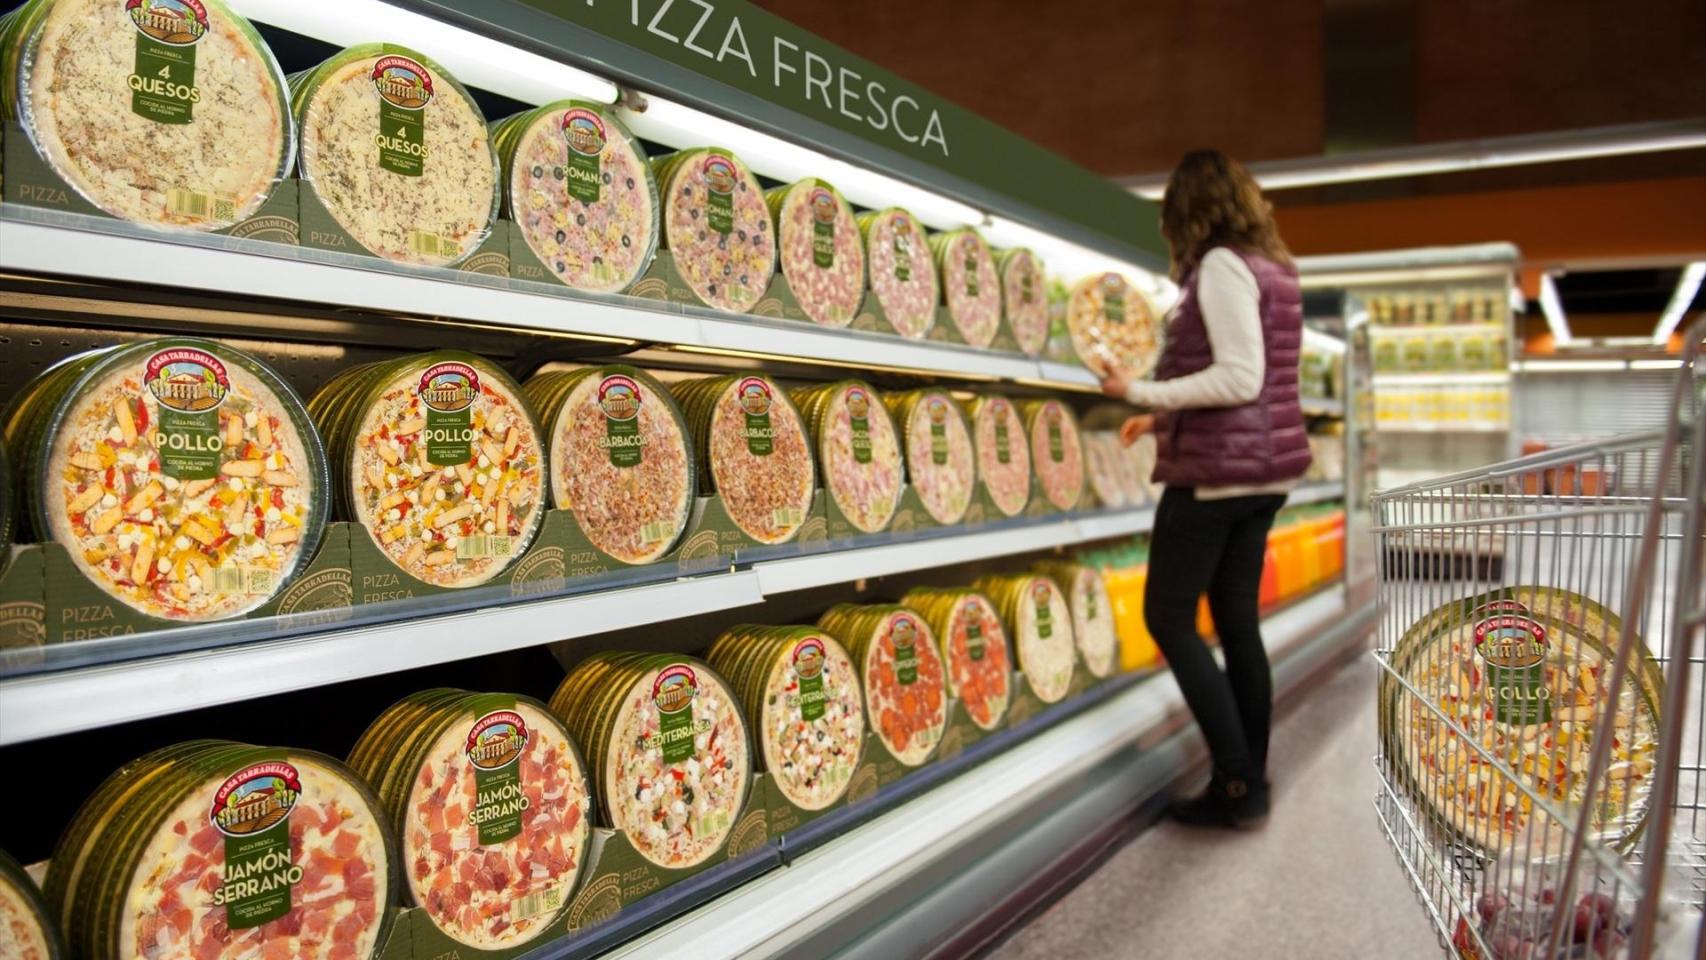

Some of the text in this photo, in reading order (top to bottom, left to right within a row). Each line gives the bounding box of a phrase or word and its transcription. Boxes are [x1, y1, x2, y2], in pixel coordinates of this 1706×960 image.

[158, 64, 170, 80] 4
[586, 0, 949, 156] IZZA FRESCA
[127, 74, 200, 102] QUESOS
[396, 126, 407, 138] 4
[375, 134, 429, 158] QUESOS
[20, 184, 70, 205] PIZZA
[311, 231, 347, 247] PIZZA
[151, 351, 223, 373] CASA TARRADELLAS
[155, 432, 222, 452] POLLO
[424, 428, 473, 442] POLLO
[600, 434, 648, 448] BARBACOA
[571, 552, 598, 564] PIZZA
[296, 572, 351, 596] TARRADELLAS
[363, 574, 400, 588] PIZZA
[364, 589, 416, 606] FRESCA
[62, 605, 115, 624] PIZZA
[63, 625, 136, 643] FRESCA
[1488, 686, 1550, 700] POLLO
[218, 765, 294, 800] CASA TARRADELLAS
[476, 781, 524, 808] JAMÓN
[468, 796, 530, 826] SERRANO
[224, 848, 292, 884] JAMÓN
[622, 866, 650, 883] PIZZA
[213, 866, 304, 906] SERRANO
[624, 877, 660, 900] FRESCA
